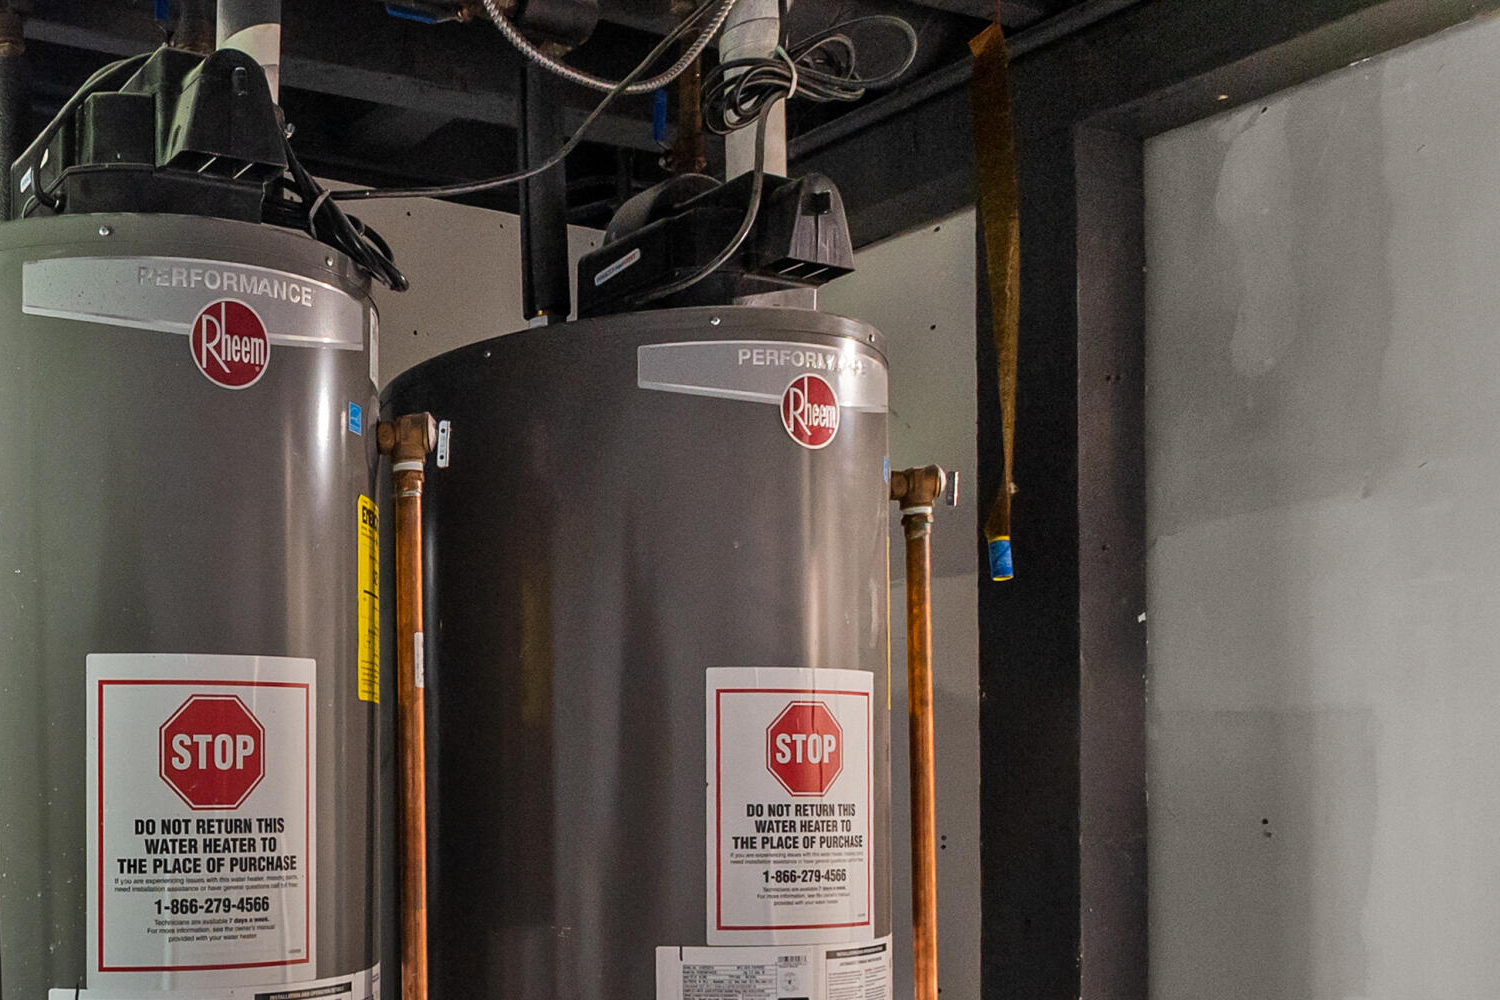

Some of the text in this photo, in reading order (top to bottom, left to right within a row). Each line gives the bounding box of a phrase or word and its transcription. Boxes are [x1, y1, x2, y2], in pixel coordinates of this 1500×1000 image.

[138, 266, 314, 307] PERFORMANCE
[202, 302, 265, 373] Rheem
[789, 377, 836, 436] Rheem
[171, 733, 255, 770] STOP
[775, 733, 837, 764] STOP
[746, 803, 856, 817] DO NOT RETURN THIS
[134, 817, 285, 835] DO NOT RETURN THIS
[755, 819, 851, 833] WATER HEATER TO
[145, 836, 277, 855] WATER HEATER TO
[732, 835, 863, 849] THE PLACE OF PURCHASE
[117, 855, 297, 874] THE PLACE OF PURCHASE
[762, 868, 847, 883] 1-866-279-4566
[154, 896, 270, 915] 1-866-279-4566
